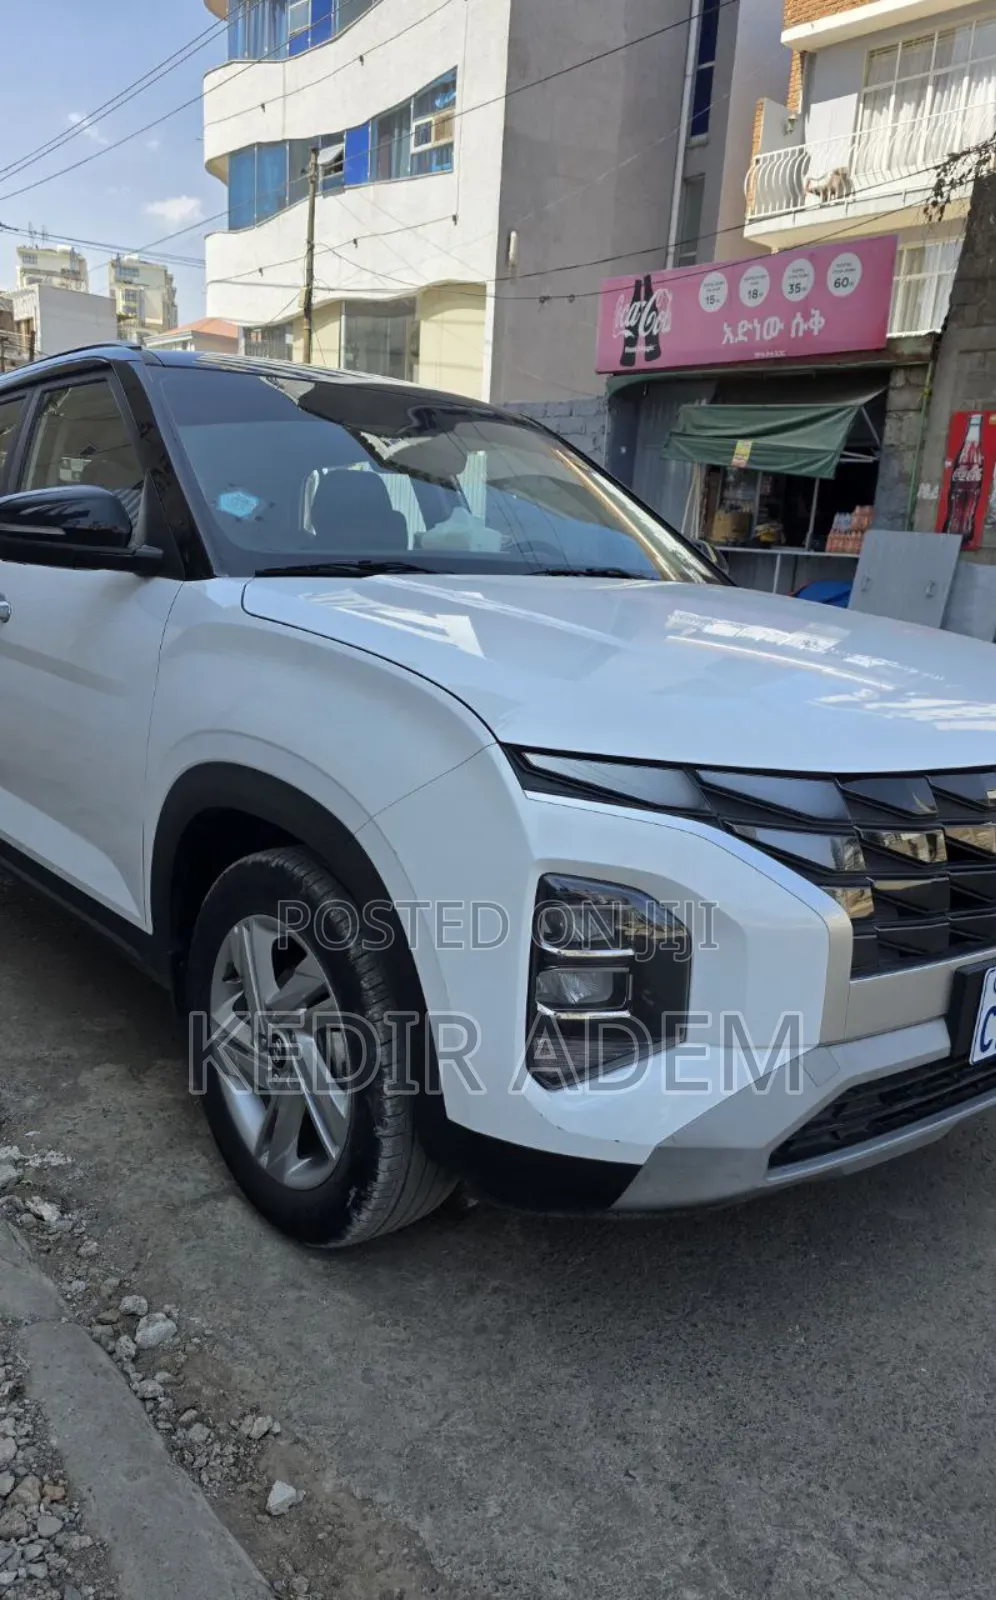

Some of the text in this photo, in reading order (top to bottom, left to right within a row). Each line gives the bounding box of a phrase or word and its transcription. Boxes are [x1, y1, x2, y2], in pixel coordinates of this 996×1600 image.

[788, 283, 802, 295] 35
[834, 277, 850, 289] 60
[706, 295, 716, 305] 15
[747, 288, 759, 300] 18
